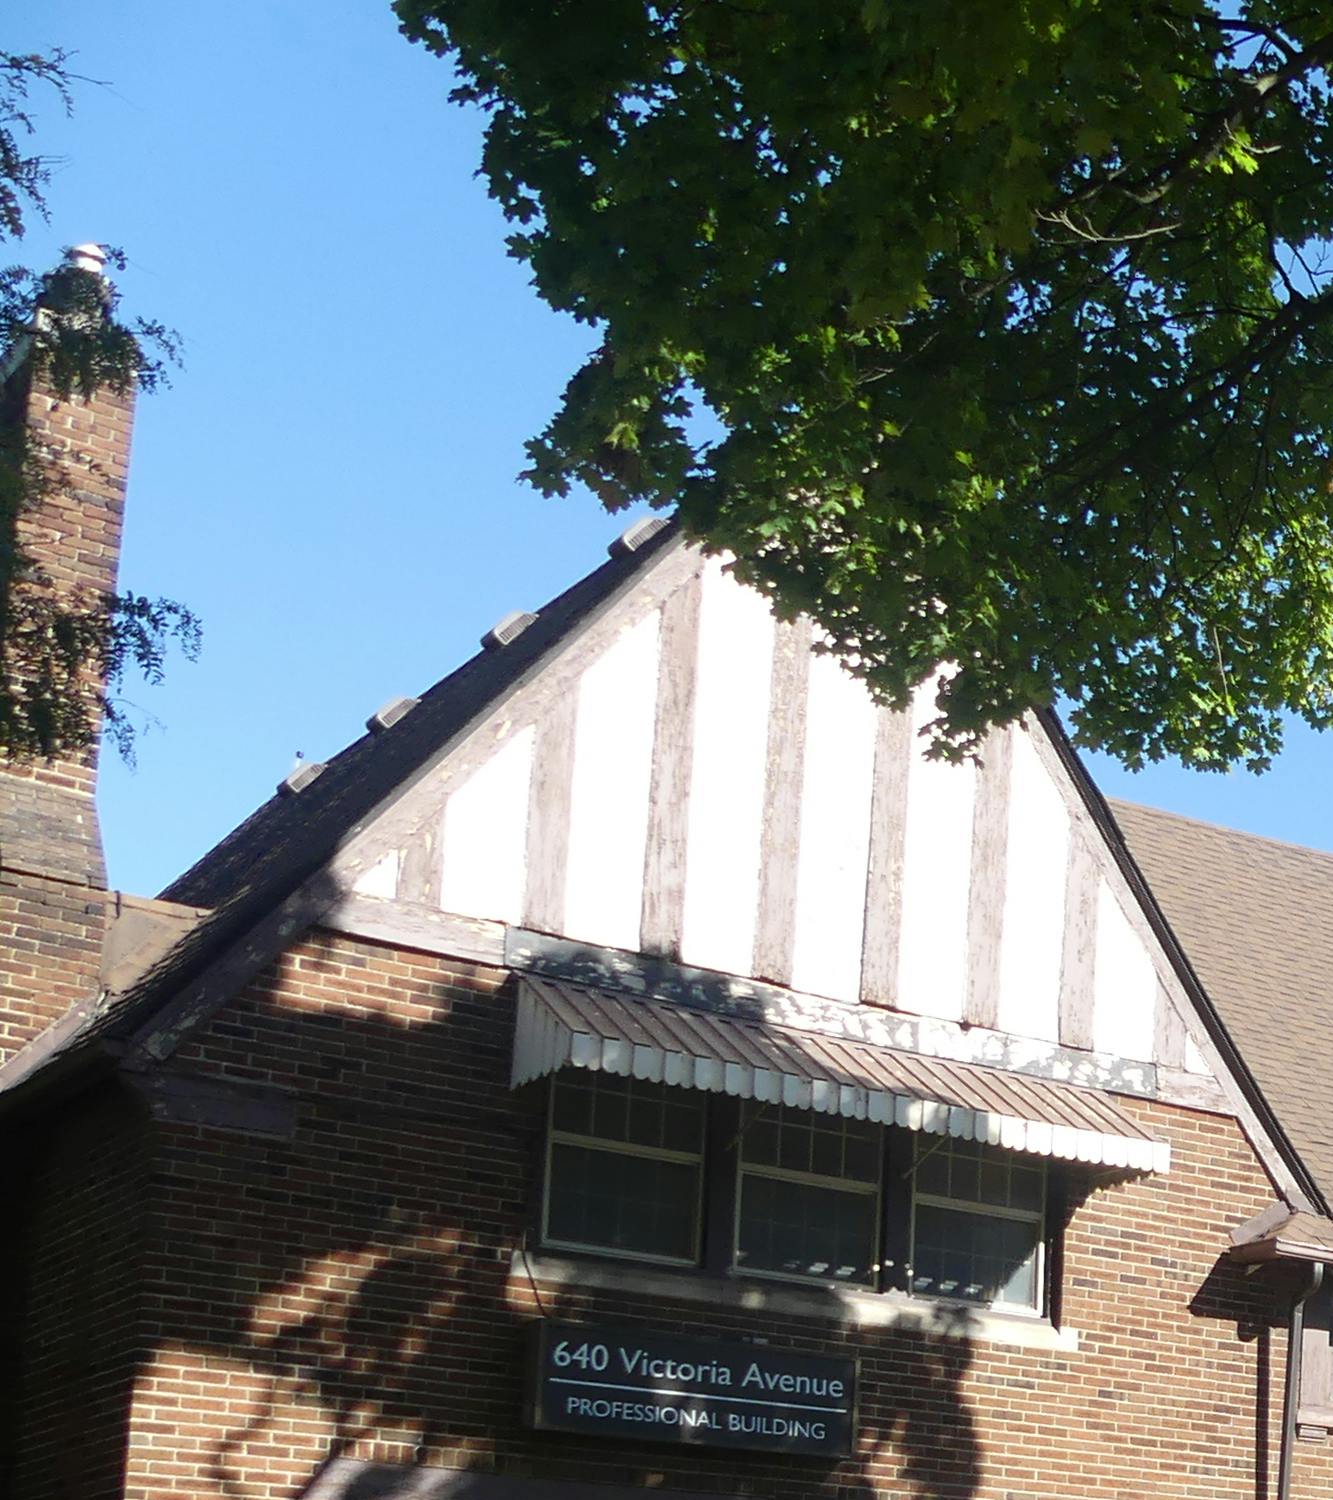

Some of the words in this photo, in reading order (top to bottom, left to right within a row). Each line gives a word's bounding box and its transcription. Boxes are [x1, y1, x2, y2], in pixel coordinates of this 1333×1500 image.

[553, 1341, 608, 1371] 640
[620, 1348, 731, 1385] Victoria
[742, 1363, 844, 1398] Avenue
[567, 1397, 722, 1429] PROFESSIONAL
[728, 1414, 826, 1440] BUILDING
